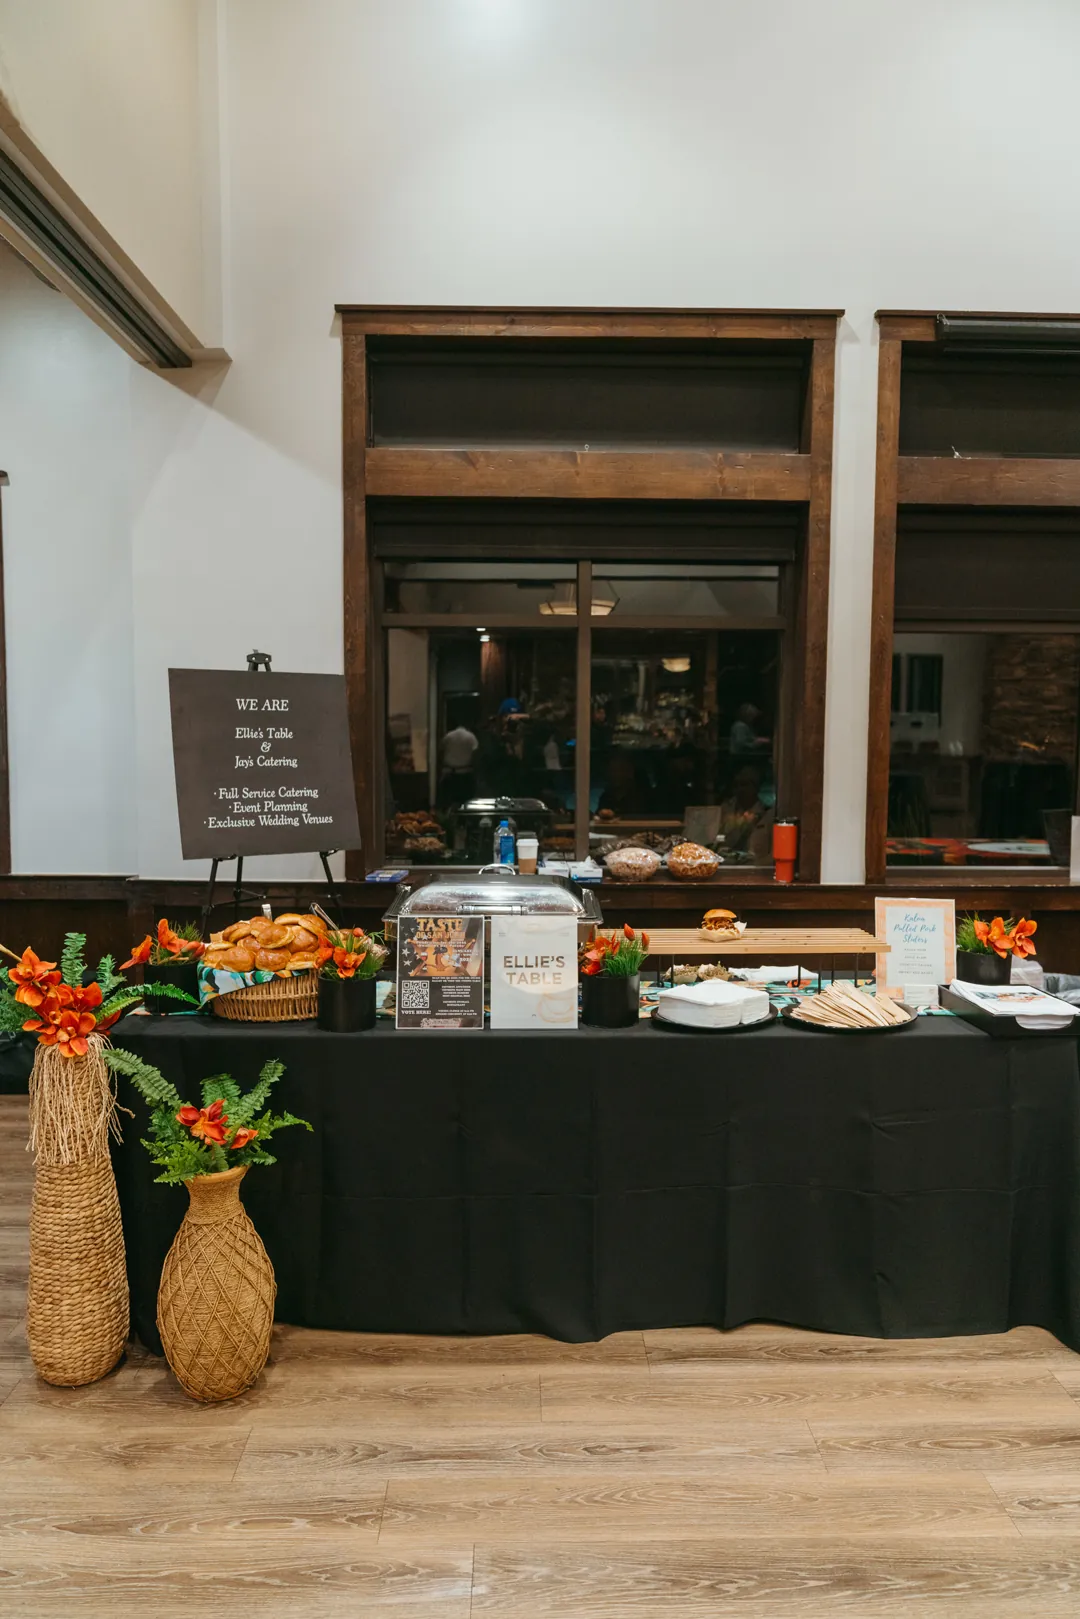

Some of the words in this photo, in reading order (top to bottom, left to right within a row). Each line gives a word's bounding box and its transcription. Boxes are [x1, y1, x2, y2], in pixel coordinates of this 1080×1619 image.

[236, 699, 258, 711] WE
[261, 699, 289, 711] ARE
[235, 728, 263, 739] Ellie's
[267, 728, 293, 739] Table
[261, 742, 271, 752] &
[235, 756, 254, 769] Jay's
[257, 756, 298, 769] Catering
[218, 788, 238, 799] Full
[242, 788, 275, 799] Service
[278, 787, 318, 799] Catering
[233, 802, 261, 813] Event
[264, 801, 308, 813] Planning
[208, 817, 255, 829] Exclusive
[258, 815, 299, 827] Wedding
[302, 813, 333, 824] Venues
[416, 918, 463, 931] TASTE
[893, 923, 918, 932] Pulled
[920, 924, 937, 932] Pork
[427, 931, 443, 939] SAN
[903, 933, 928, 944] Sliders
[503, 955, 566, 968] ELLIE'S
[506, 972, 562, 985] TABLE
